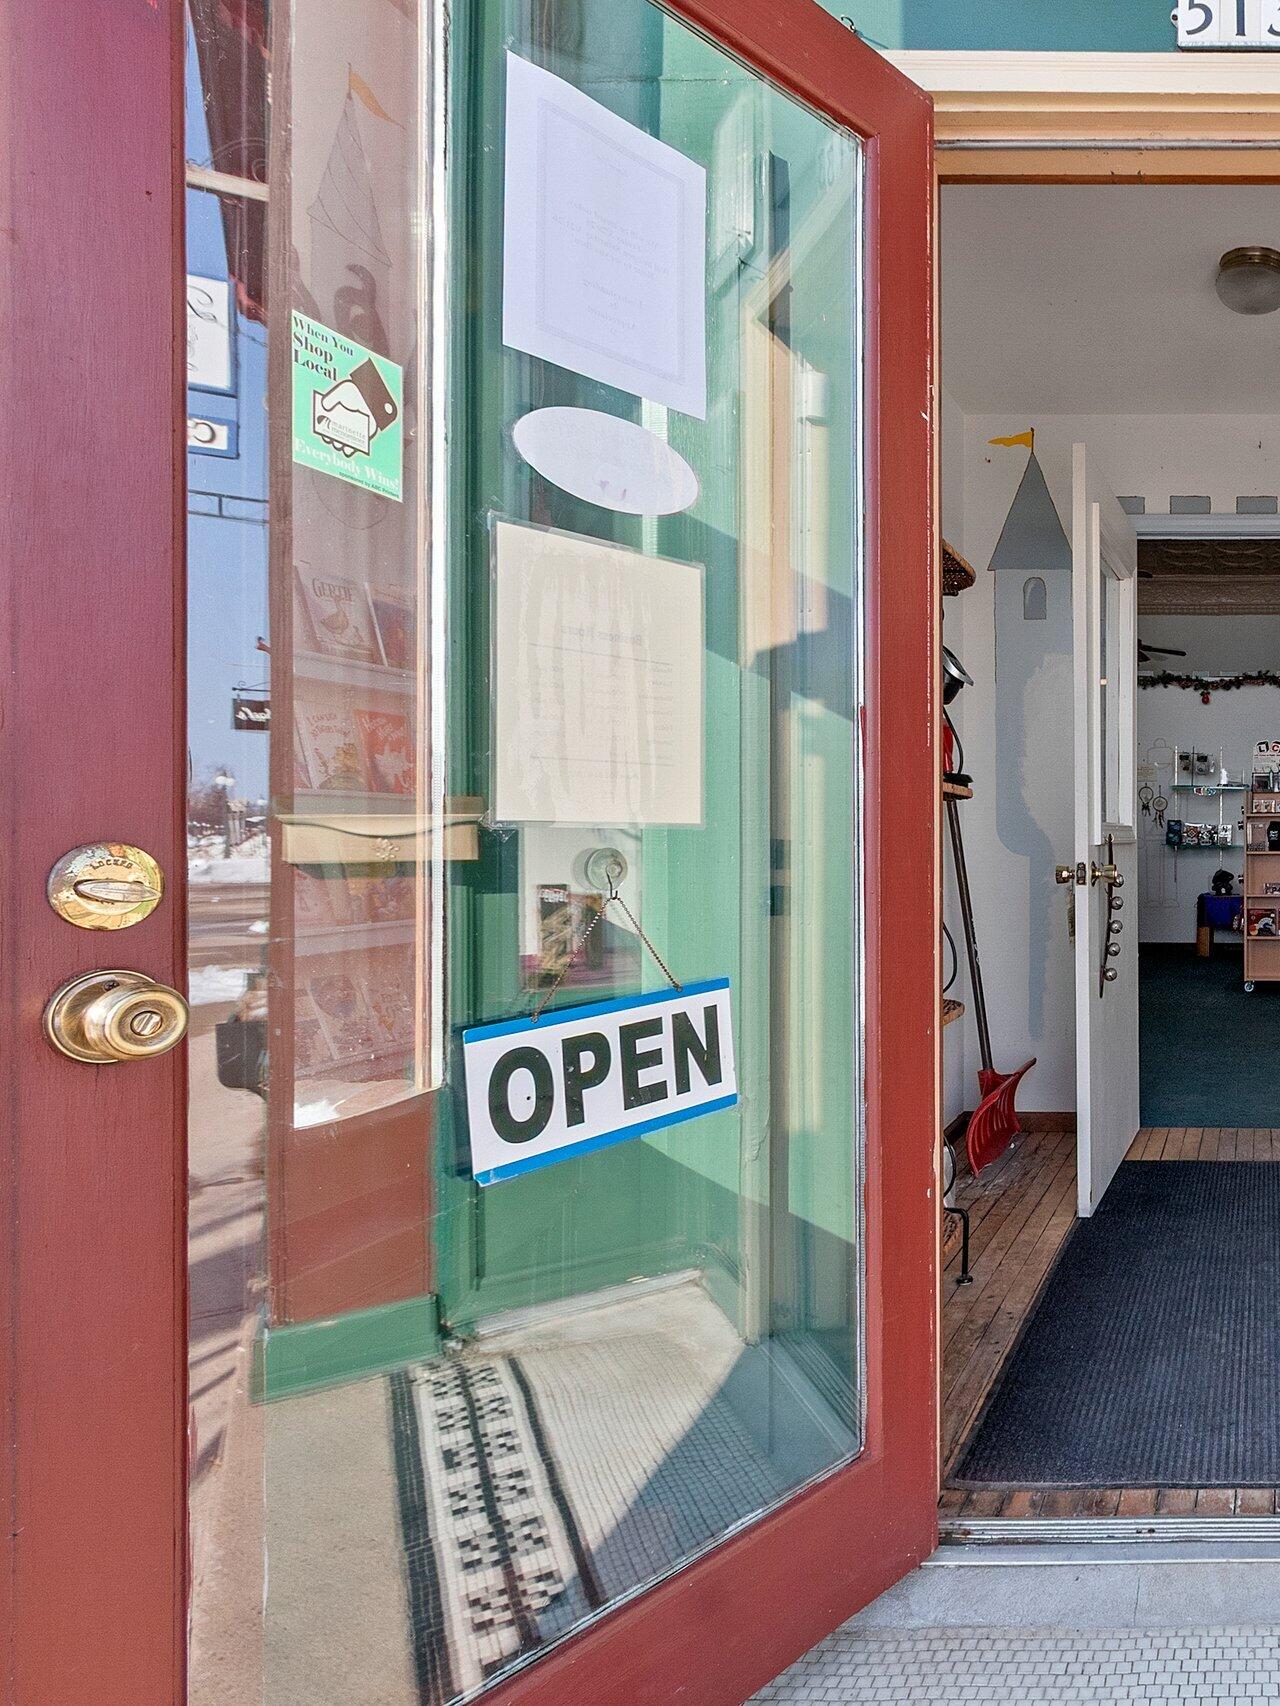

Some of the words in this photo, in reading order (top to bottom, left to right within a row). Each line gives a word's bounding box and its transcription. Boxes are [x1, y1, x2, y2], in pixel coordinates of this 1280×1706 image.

[293, 315, 329, 343] When
[332, 335, 354, 356] You
[293, 331, 333, 364] Shop
[294, 348, 337, 381] Local
[295, 437, 362, 478] Everybody
[364, 464, 400, 490] Wins!
[89, 858, 133, 870] LOCKED
[487, 1003, 722, 1144] OPEN
